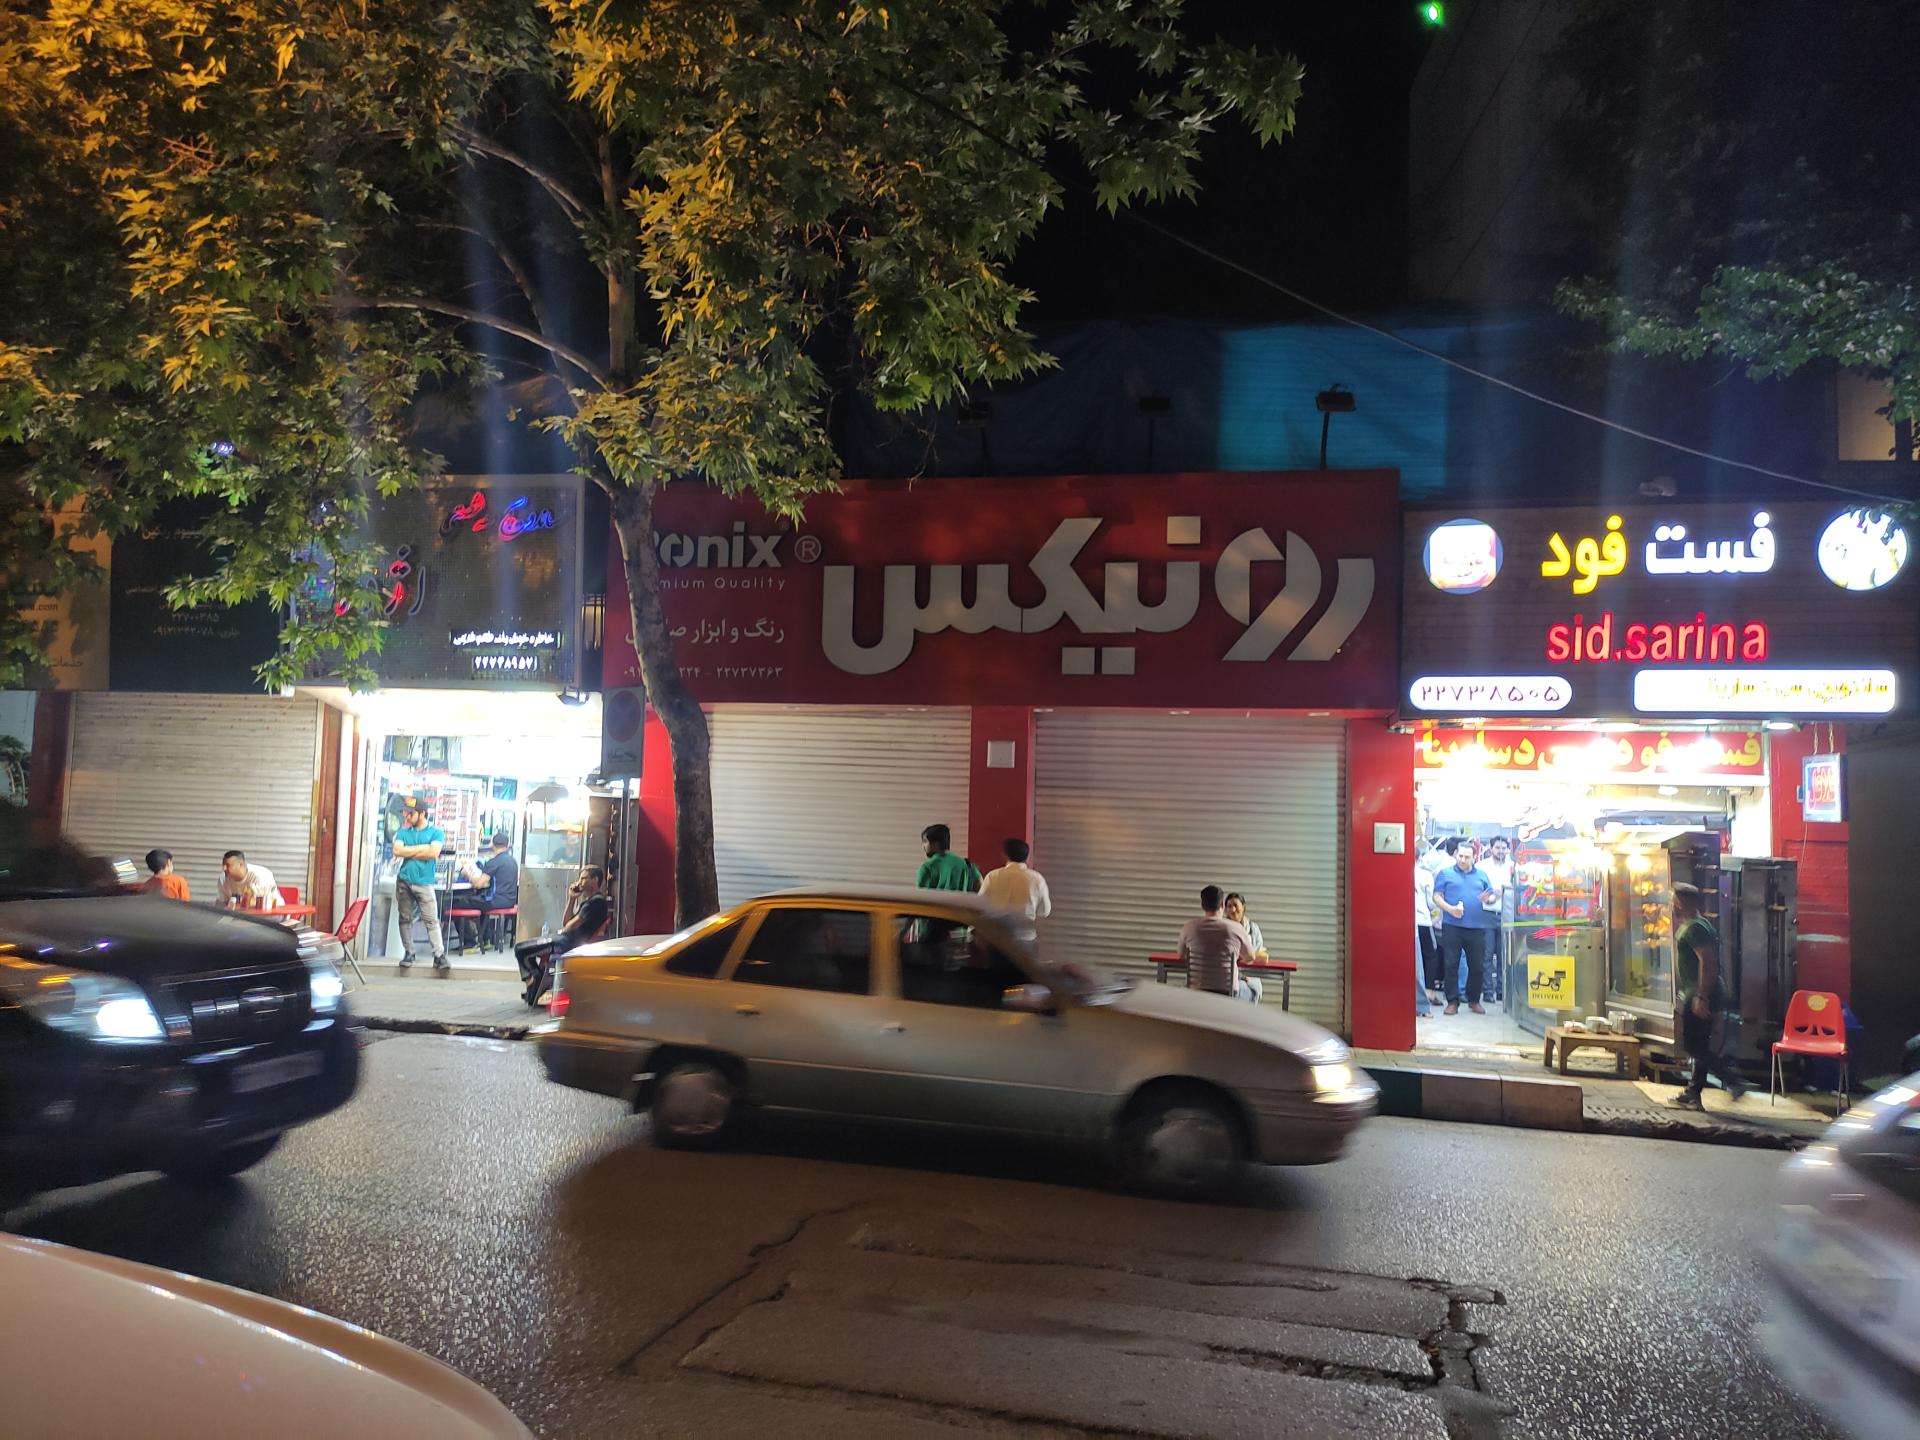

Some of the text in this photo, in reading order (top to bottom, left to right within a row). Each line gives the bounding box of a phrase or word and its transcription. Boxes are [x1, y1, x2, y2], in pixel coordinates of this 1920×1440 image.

[653, 520, 782, 568] onix
[1541, 510, 1776, 595] فست فود
[714, 576, 786, 591] Quality
[821, 516, 1375, 675] رونیکس
[690, 618, 727, 643] ابزار
[730, 628, 740, 643] و
[743, 617, 785, 644] رنگ
[1547, 610, 1768, 663] sid.sarina
[1421, 684, 1561, 703] ۲۲۷۳۸۵۰۵
[1531, 993, 1566, 1002] DELIVERY
